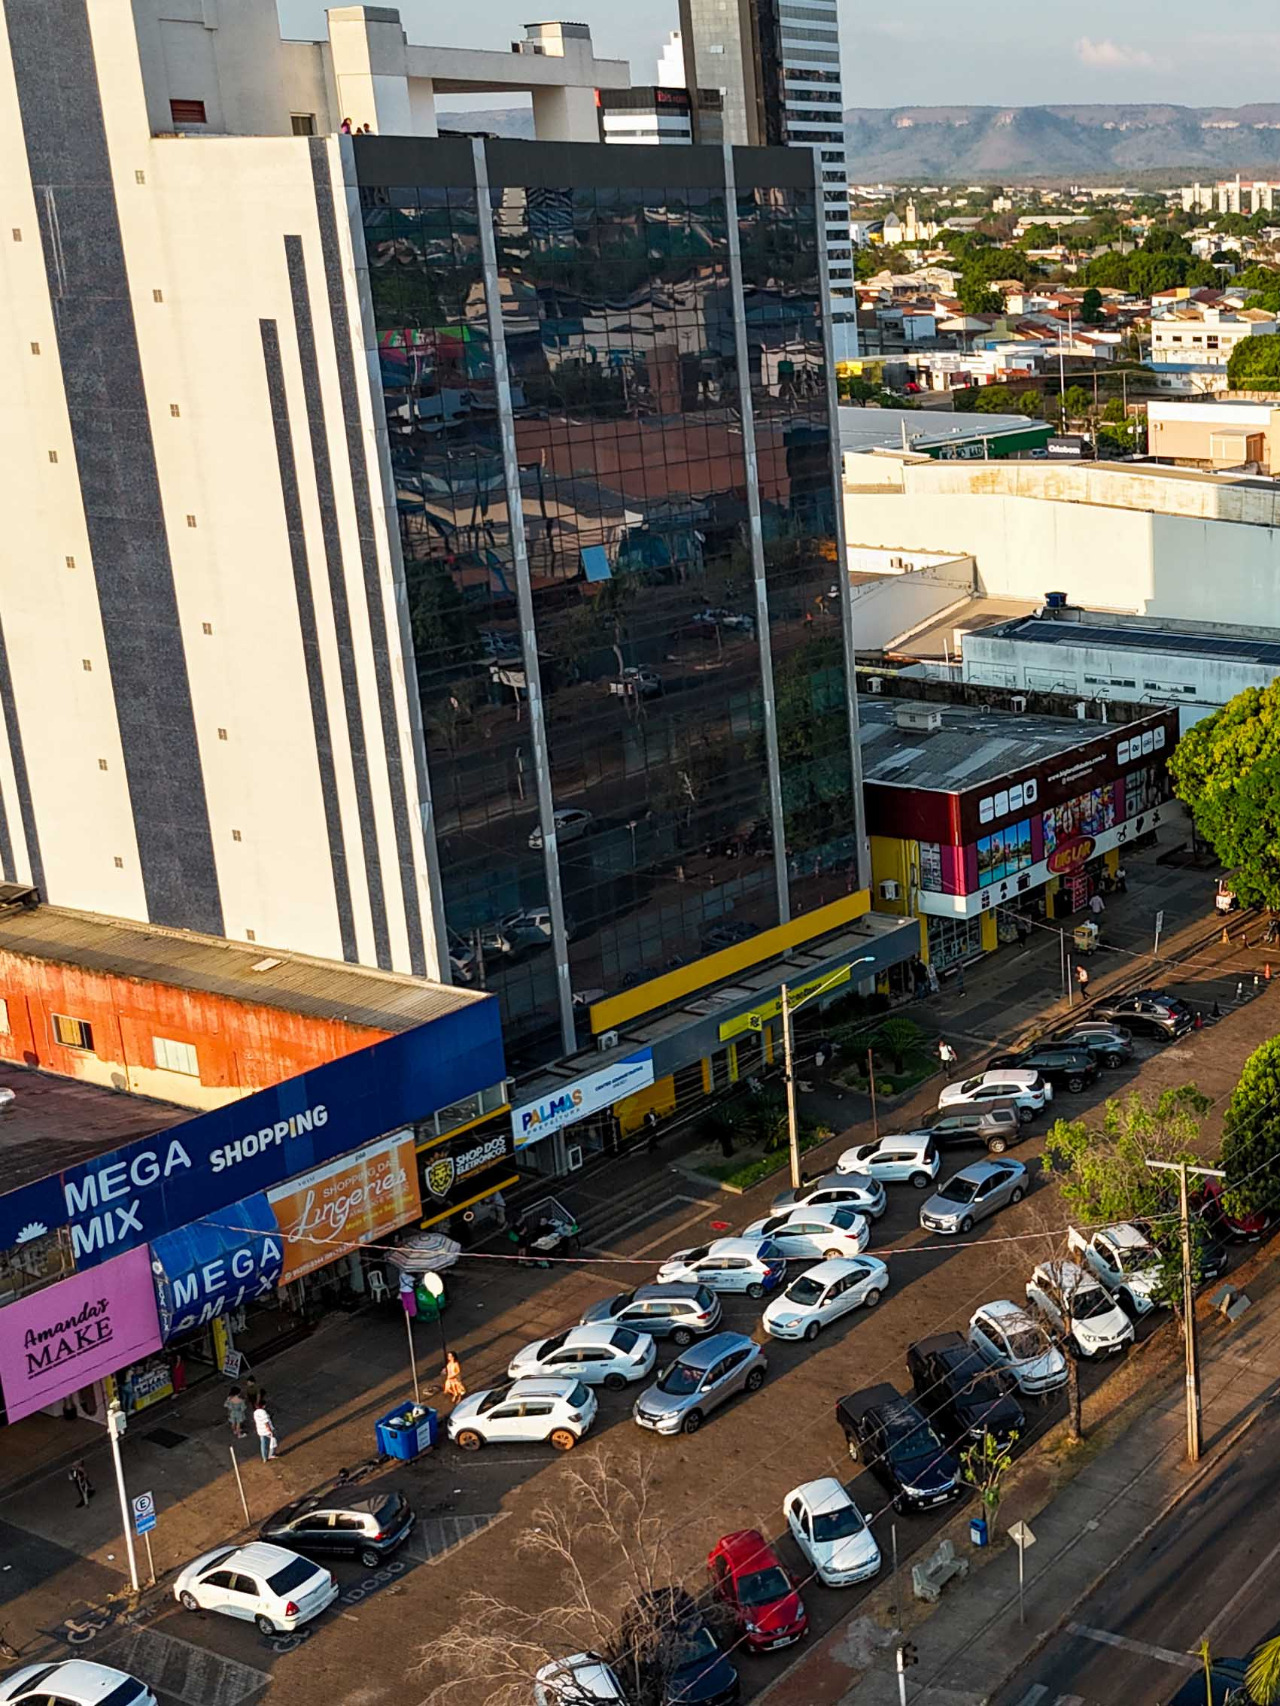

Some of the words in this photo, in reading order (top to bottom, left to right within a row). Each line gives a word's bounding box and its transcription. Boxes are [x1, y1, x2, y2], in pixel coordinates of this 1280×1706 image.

[521, 1088, 583, 1132] PALMAS
[526, 1107, 581, 1136] PREFEITURA
[209, 1104, 329, 1173] SHOPPING
[456, 1146, 483, 1167] SHOP
[484, 1134, 506, 1153] DOS
[64, 1139, 192, 1217] MEGA
[323, 1168, 377, 1198] SHOPPING
[71, 1199, 144, 1259] MIX
[287, 1168, 407, 1244] Lingeries
[173, 1237, 281, 1309] MEGA
[198, 1268, 280, 1326] MIX
[24, 1298, 109, 1349] Amanda's
[25, 1316, 113, 1375] MAKE
[139, 1498, 147, 1509] E
[340, 1561, 405, 1603] IDOSO
